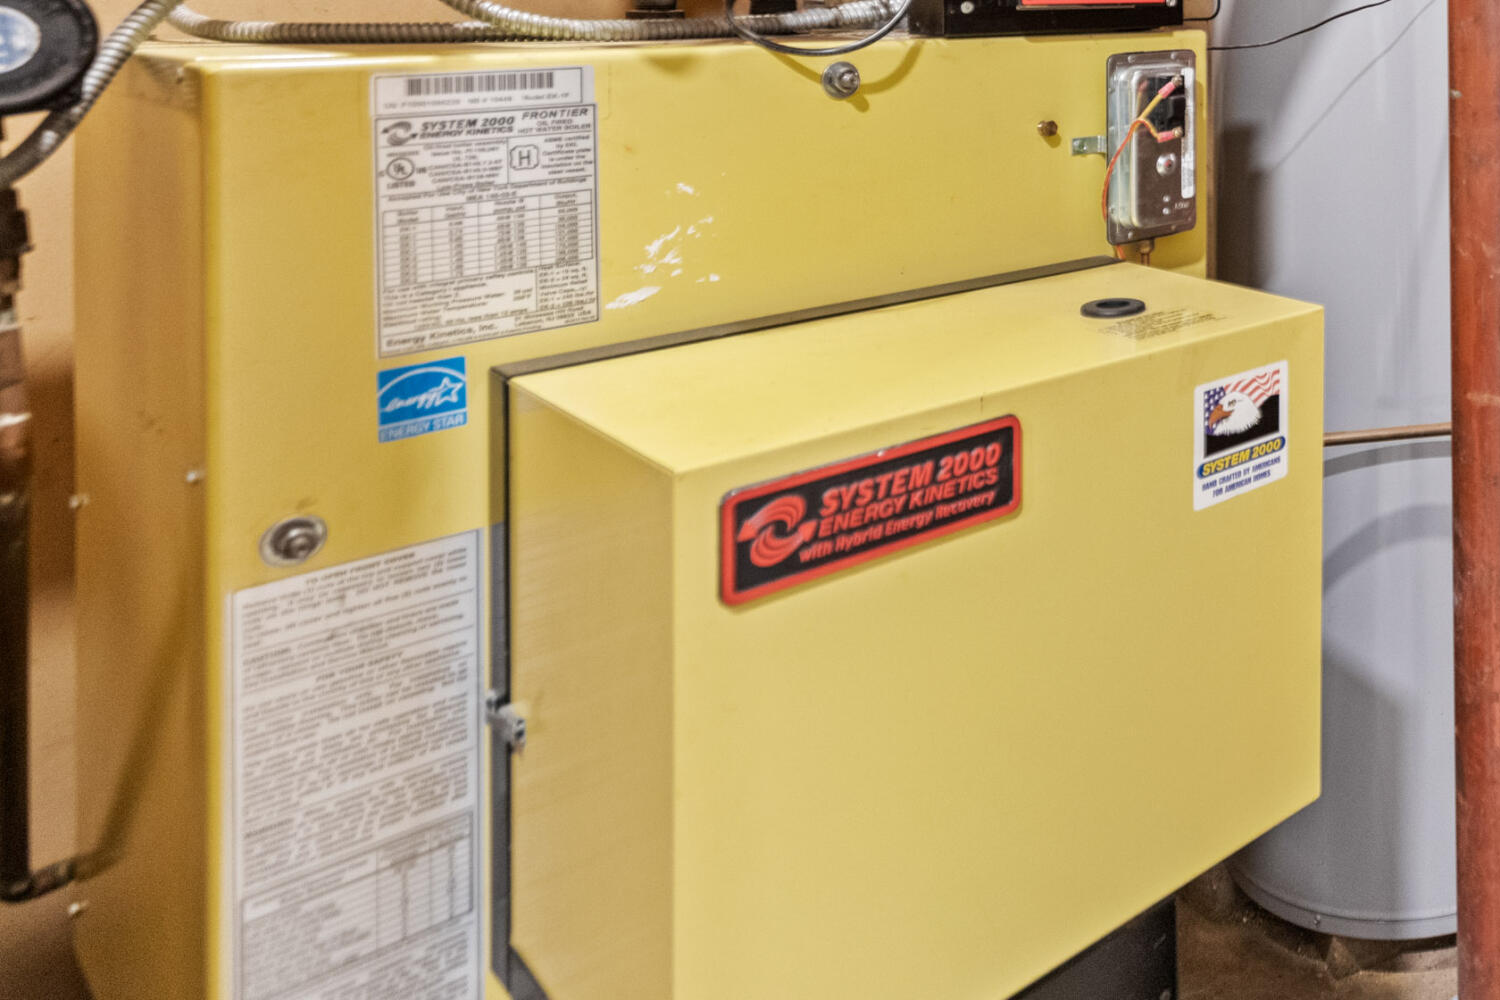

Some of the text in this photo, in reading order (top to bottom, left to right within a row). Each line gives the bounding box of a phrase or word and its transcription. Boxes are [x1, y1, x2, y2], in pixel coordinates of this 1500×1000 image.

[421, 116, 516, 132] SYSTEM 2000
[521, 108, 589, 121] FRONTIER
[419, 126, 514, 139] ENERGY KINETICS
[518, 151, 531, 167] H
[433, 414, 464, 431] STAR
[1202, 438, 1281, 477] SYSTEM 2000
[820, 441, 1002, 517] SYSTEM 2000
[1202, 455, 1281, 492] HAND CRAFTED BY AMERICANS
[1212, 469, 1271, 498] FOR AMERICAN HOMES
[817, 466, 999, 539] ENERGY KINETICS
[799, 490, 997, 563] with Hybrid Energy Recovery
